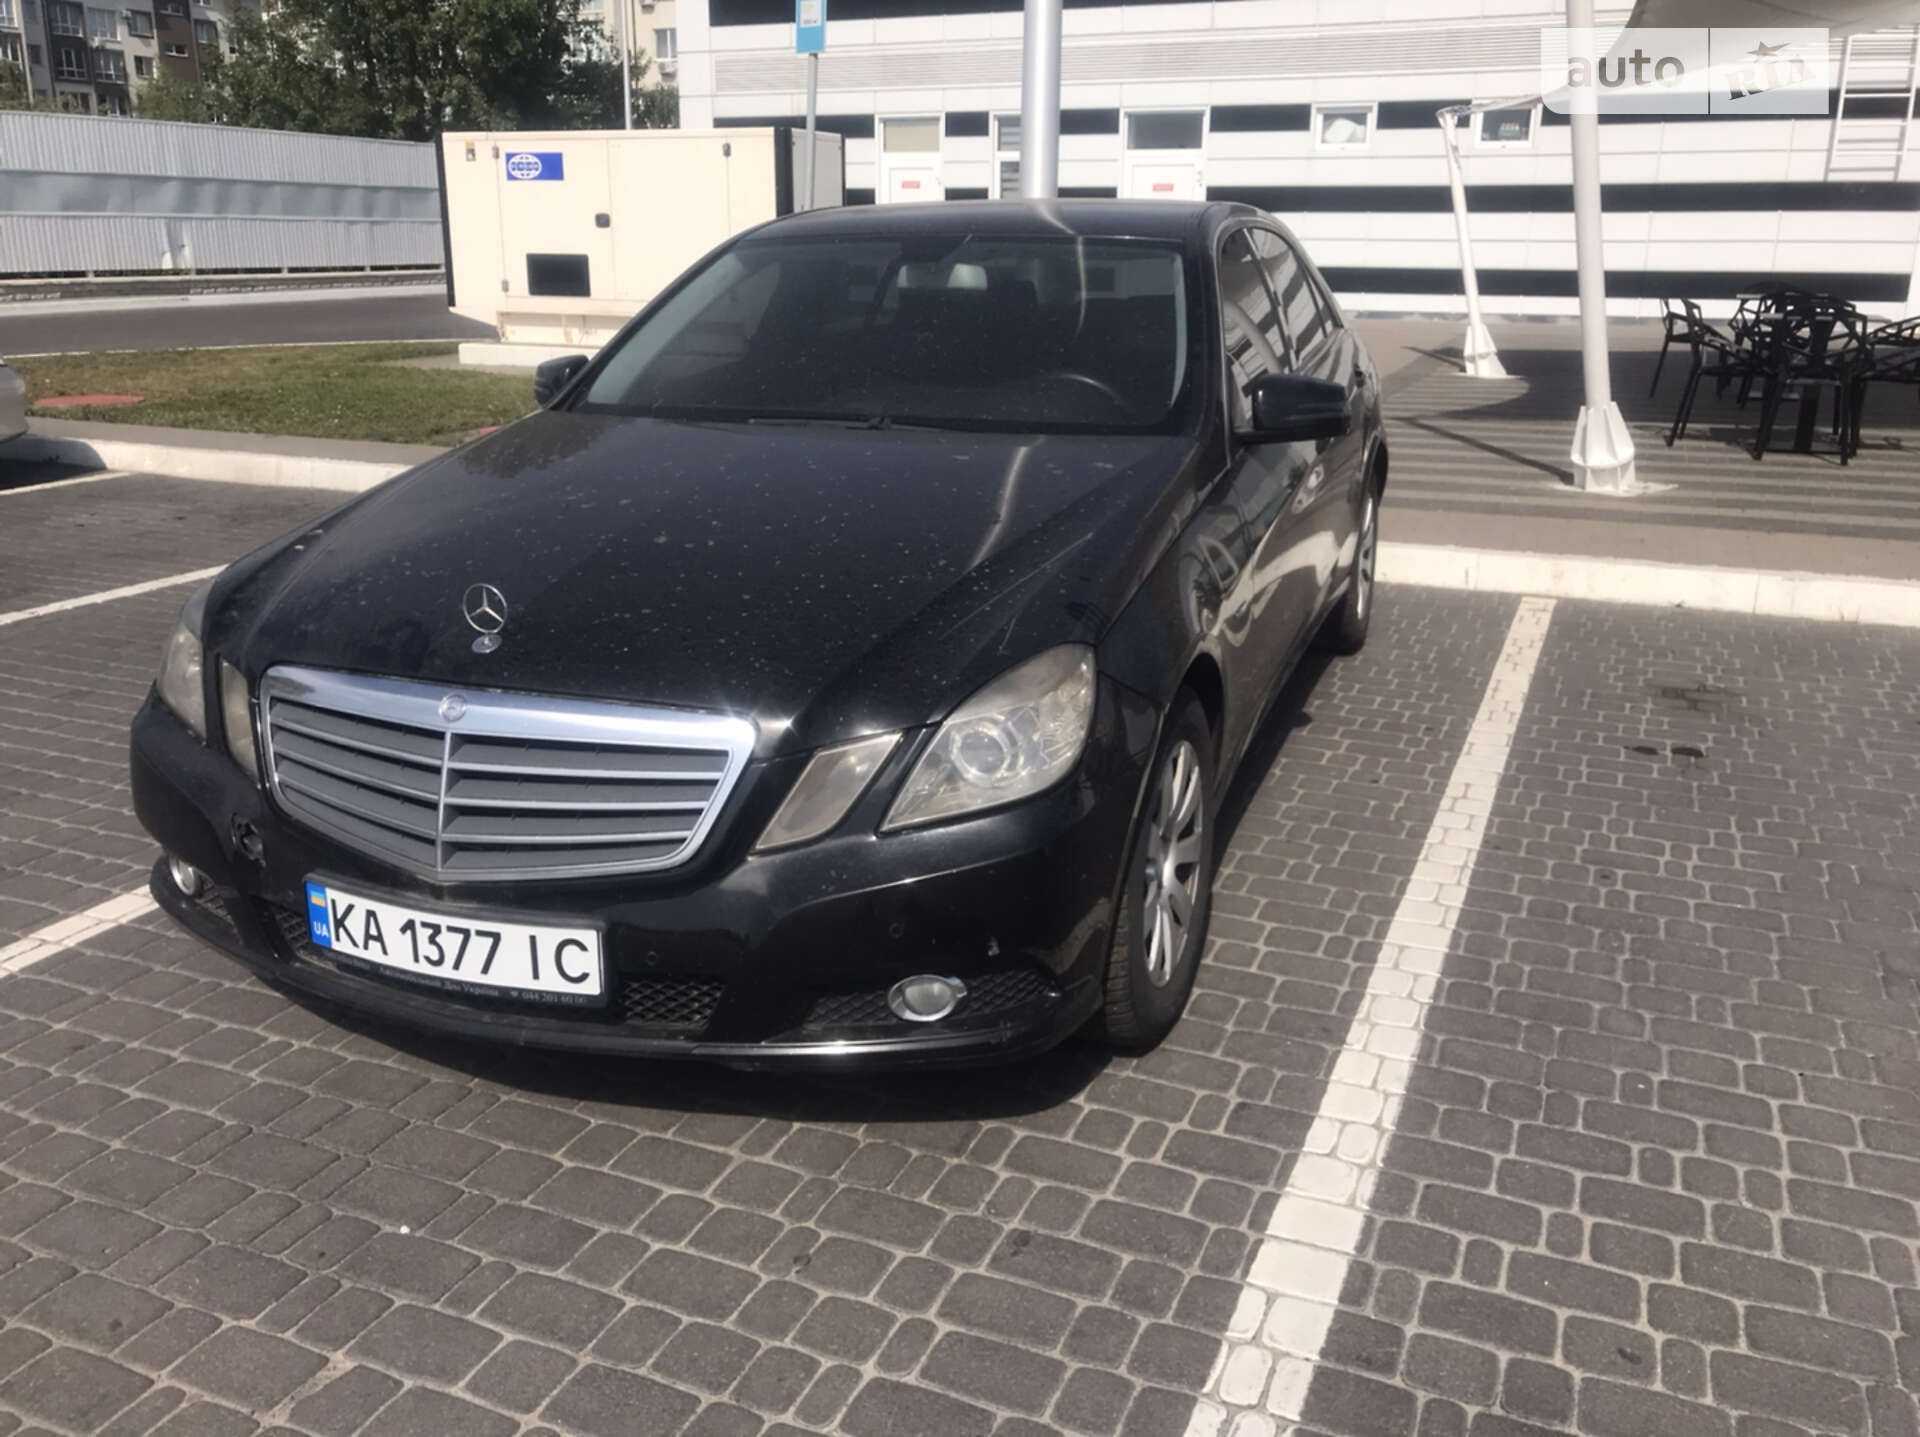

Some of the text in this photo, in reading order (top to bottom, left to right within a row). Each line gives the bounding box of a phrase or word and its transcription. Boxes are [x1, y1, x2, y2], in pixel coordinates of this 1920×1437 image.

[313, 920, 330, 938] UA
[331, 899, 591, 984] KA 1377 IC
